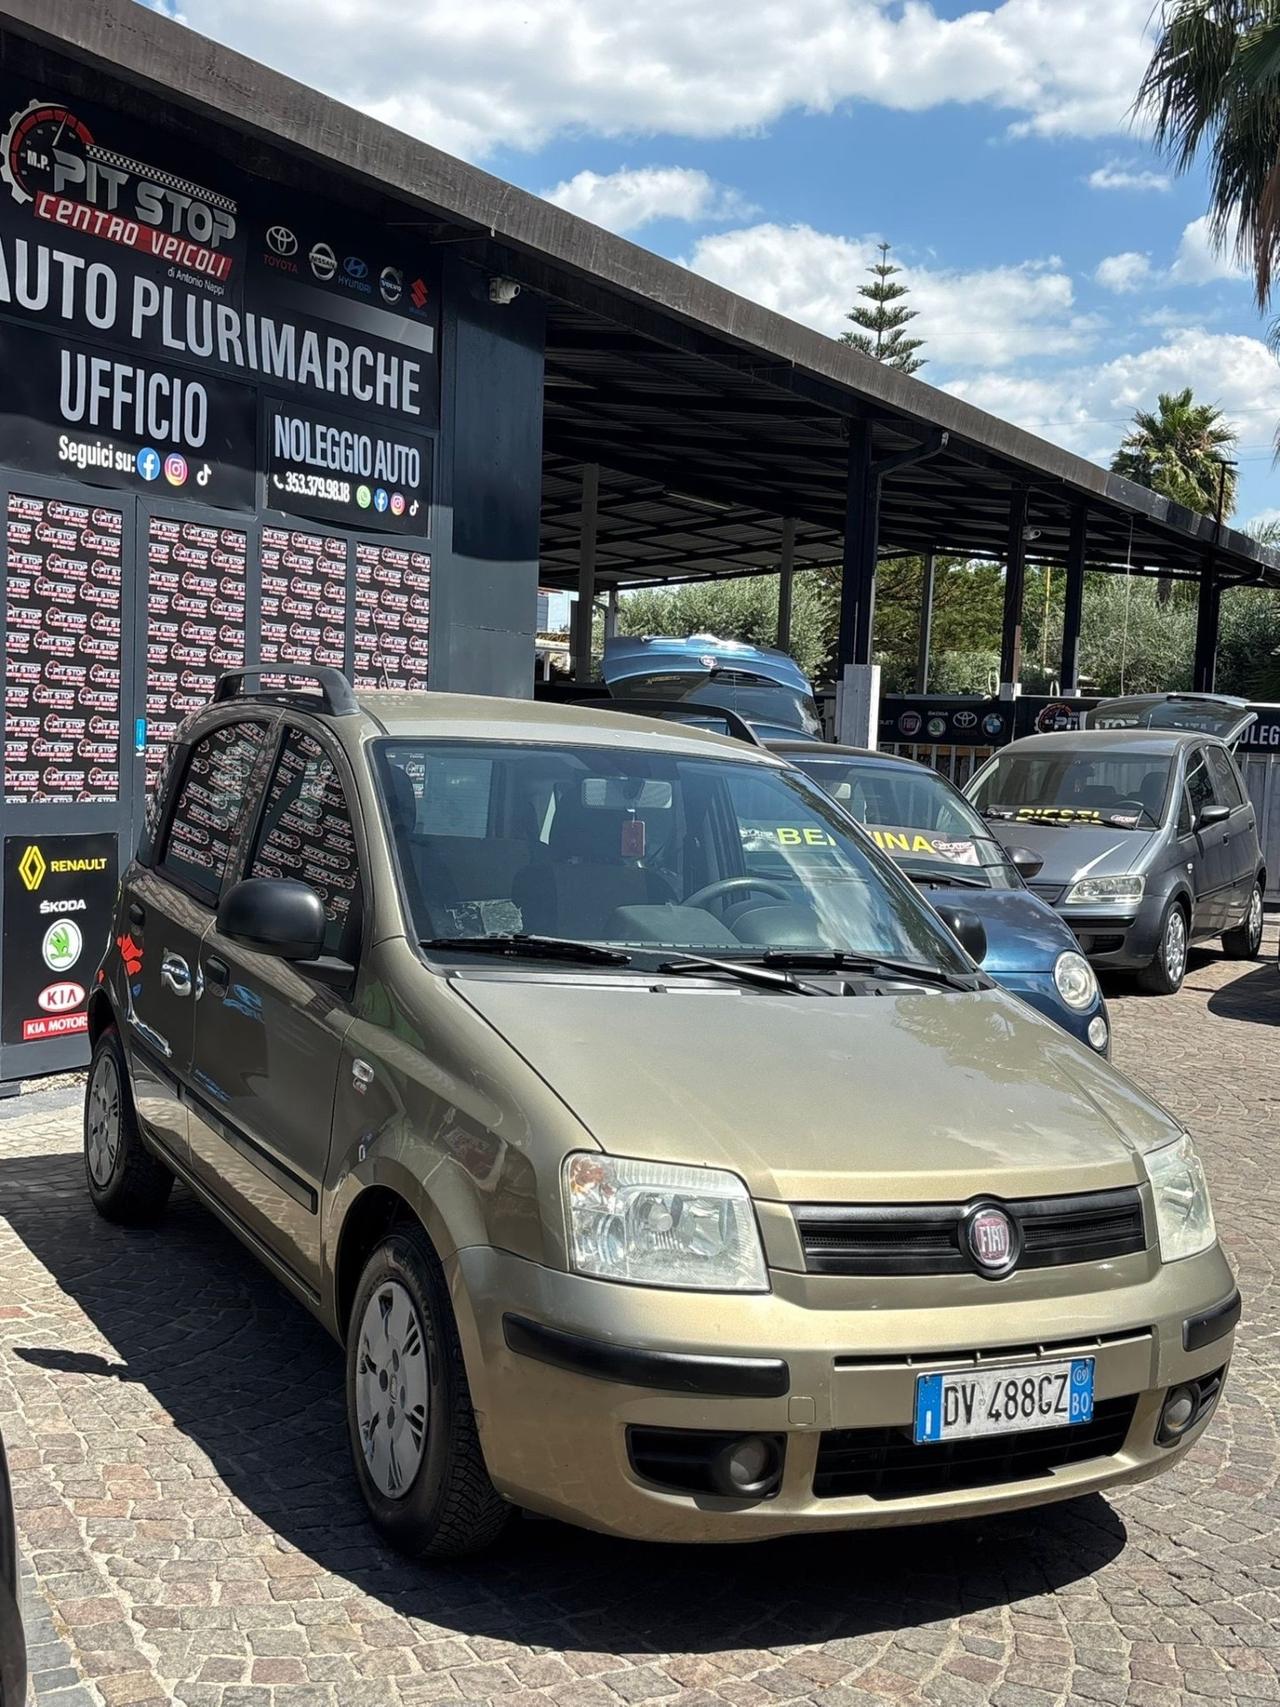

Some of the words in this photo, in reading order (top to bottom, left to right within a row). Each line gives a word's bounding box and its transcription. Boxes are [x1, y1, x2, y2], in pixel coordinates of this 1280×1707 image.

[27, 149, 50, 171] M.P.
[54, 147, 129, 210] PIT
[135, 181, 237, 249] STOP
[263, 254, 298, 274] TOYOTA
[311, 254, 336, 269] NISSAN
[176, 269, 204, 288] Antonio
[204, 279, 225, 297] Nappi
[381, 278, 402, 292] VOLVO
[131, 274, 421, 415] PLURIMARCHE
[60, 349, 208, 448] UFFICIO
[58, 434, 114, 470] Seguici
[114, 450, 137, 473] su:
[274, 414, 372, 477] NOLEGGIO
[374, 439, 420, 488] AUTO
[22, 500, 44, 510] STOP
[68, 508, 89, 518] STOP
[10, 525, 32, 533] STOP
[56, 531, 77, 540] STOP
[101, 538, 120, 548] STOP
[22, 556, 42, 564] STOP
[68, 562, 88, 570] STOP
[10, 580, 30, 588] STOP
[56, 586, 76, 594] STOP
[101, 590, 120, 599] STOP
[21, 610, 42, 619] STOP
[67, 616, 88, 624] STOP
[8, 635, 30, 643] STOP
[55, 638, 76, 646] STOP
[100, 642, 120, 650] STOP
[20, 664, 42, 672] STOP
[54, 692, 75, 700] STOP
[98, 694, 118, 702] STOP
[19, 720, 40, 728] STOP
[54, 744, 74, 752] STOP
[50, 858, 108, 873] RENAULT
[40, 898, 87, 914] ŠKODA
[47, 988, 77, 1006] KIA
[27, 1022, 46, 1035] KIA
[979, 1225, 1006, 1252] FIAT
[1076, 1369, 1087, 1381] 09
[943, 1383, 976, 1426] DV
[987, 1373, 1069, 1423] 488GZ
[1072, 1391, 1089, 1416] BO
